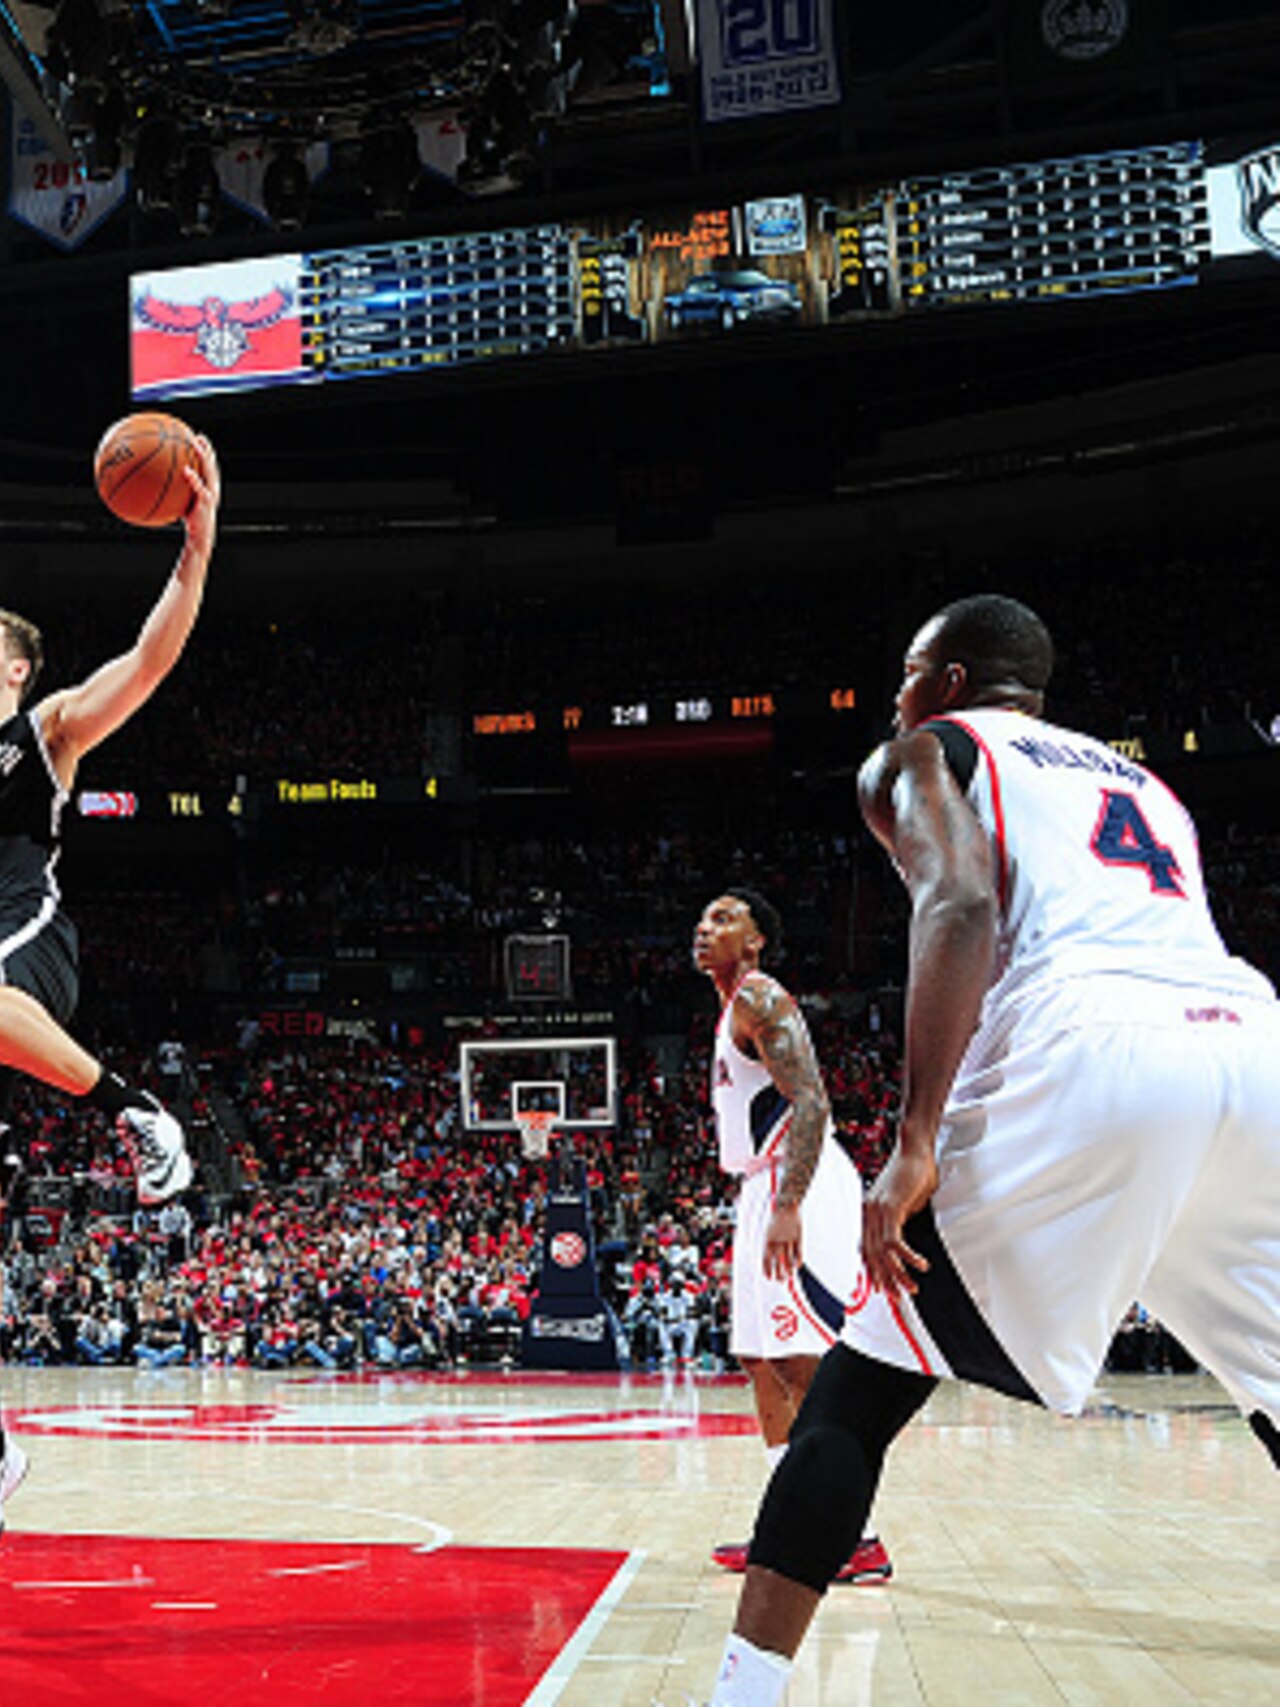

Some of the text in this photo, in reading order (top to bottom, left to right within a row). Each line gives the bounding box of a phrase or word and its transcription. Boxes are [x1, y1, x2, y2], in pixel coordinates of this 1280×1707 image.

[726, 0, 813, 58] 20
[278, 779, 328, 803] Team
[425, 776, 438, 799] 4
[1089, 787, 1189, 899] 4
[259, 1011, 325, 1037] RED
